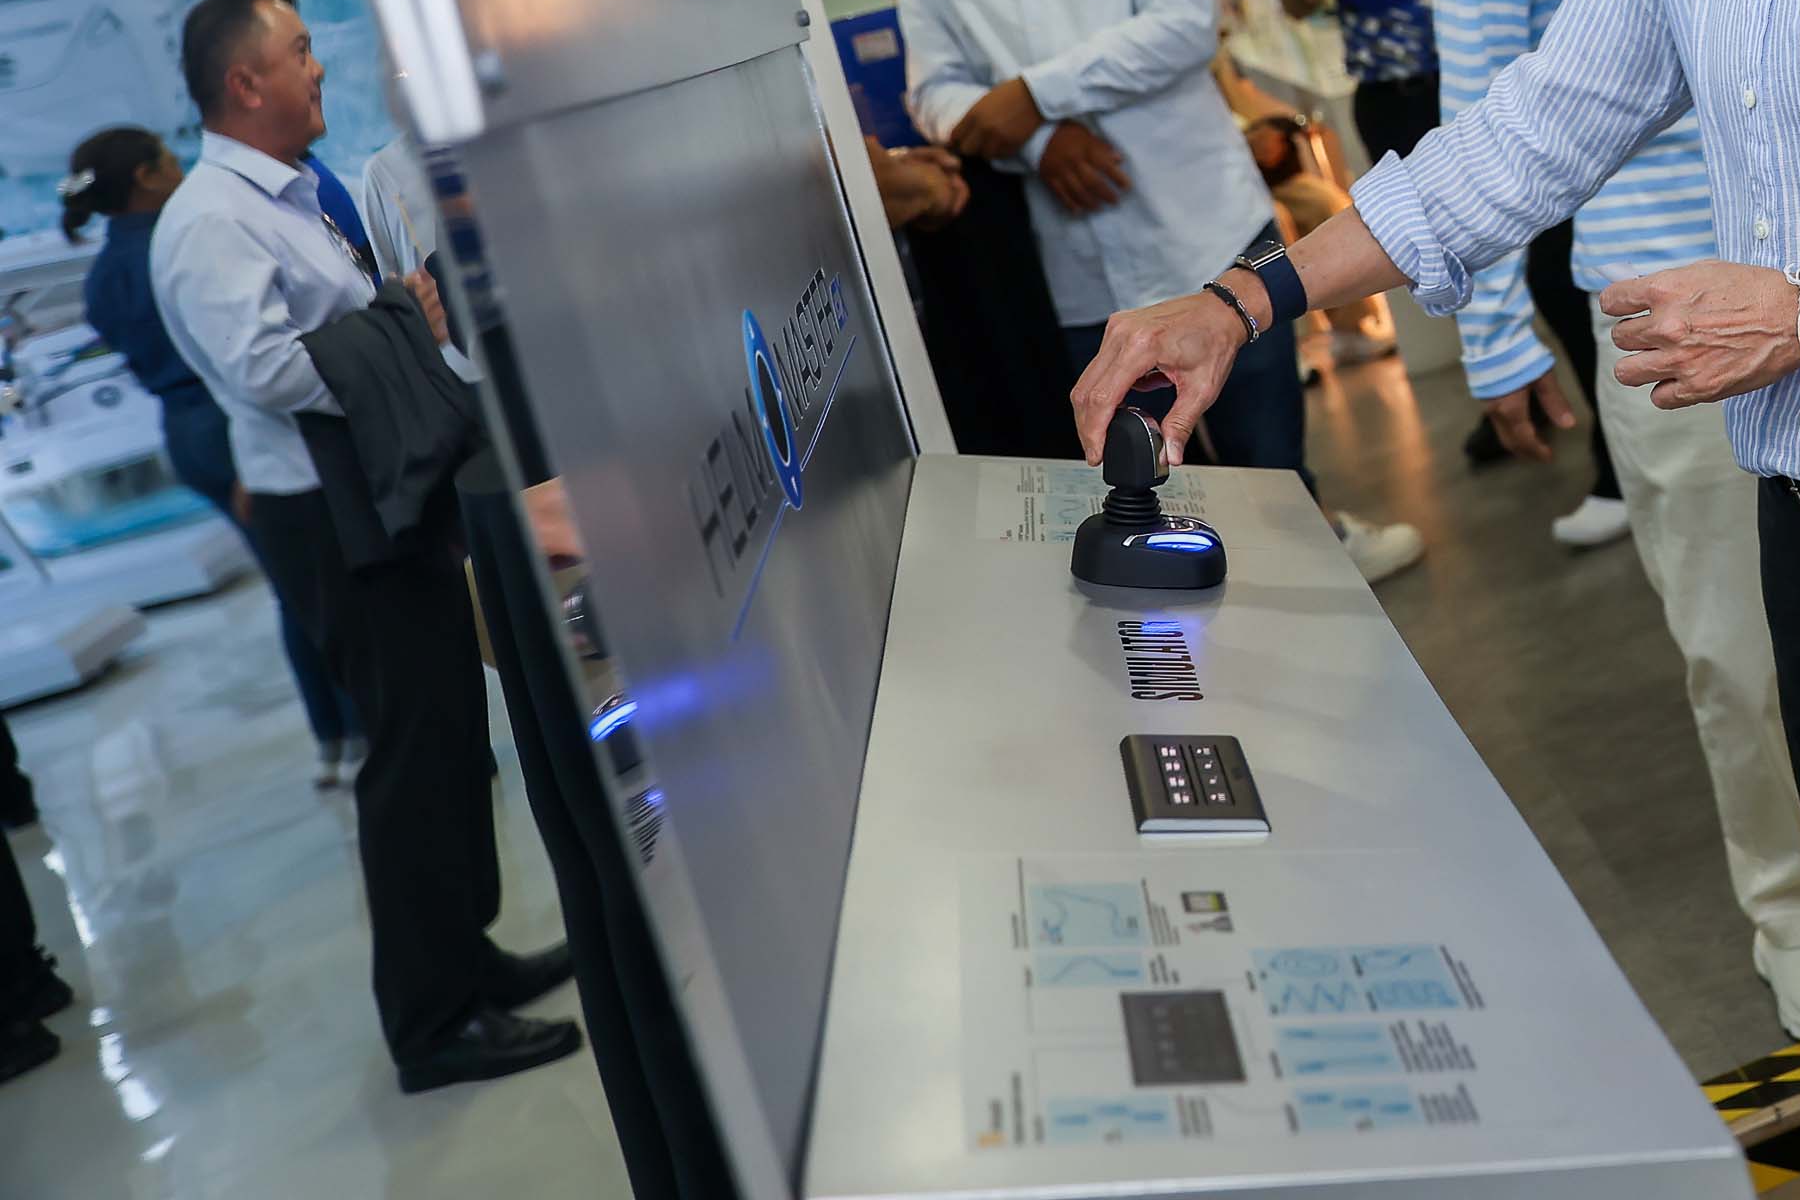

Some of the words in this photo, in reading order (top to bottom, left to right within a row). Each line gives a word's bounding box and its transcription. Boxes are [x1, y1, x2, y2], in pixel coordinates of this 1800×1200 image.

[687, 386, 773, 598] HELM
[772, 267, 839, 431] MASTER
[1118, 620, 1204, 701] SIMULATOR
